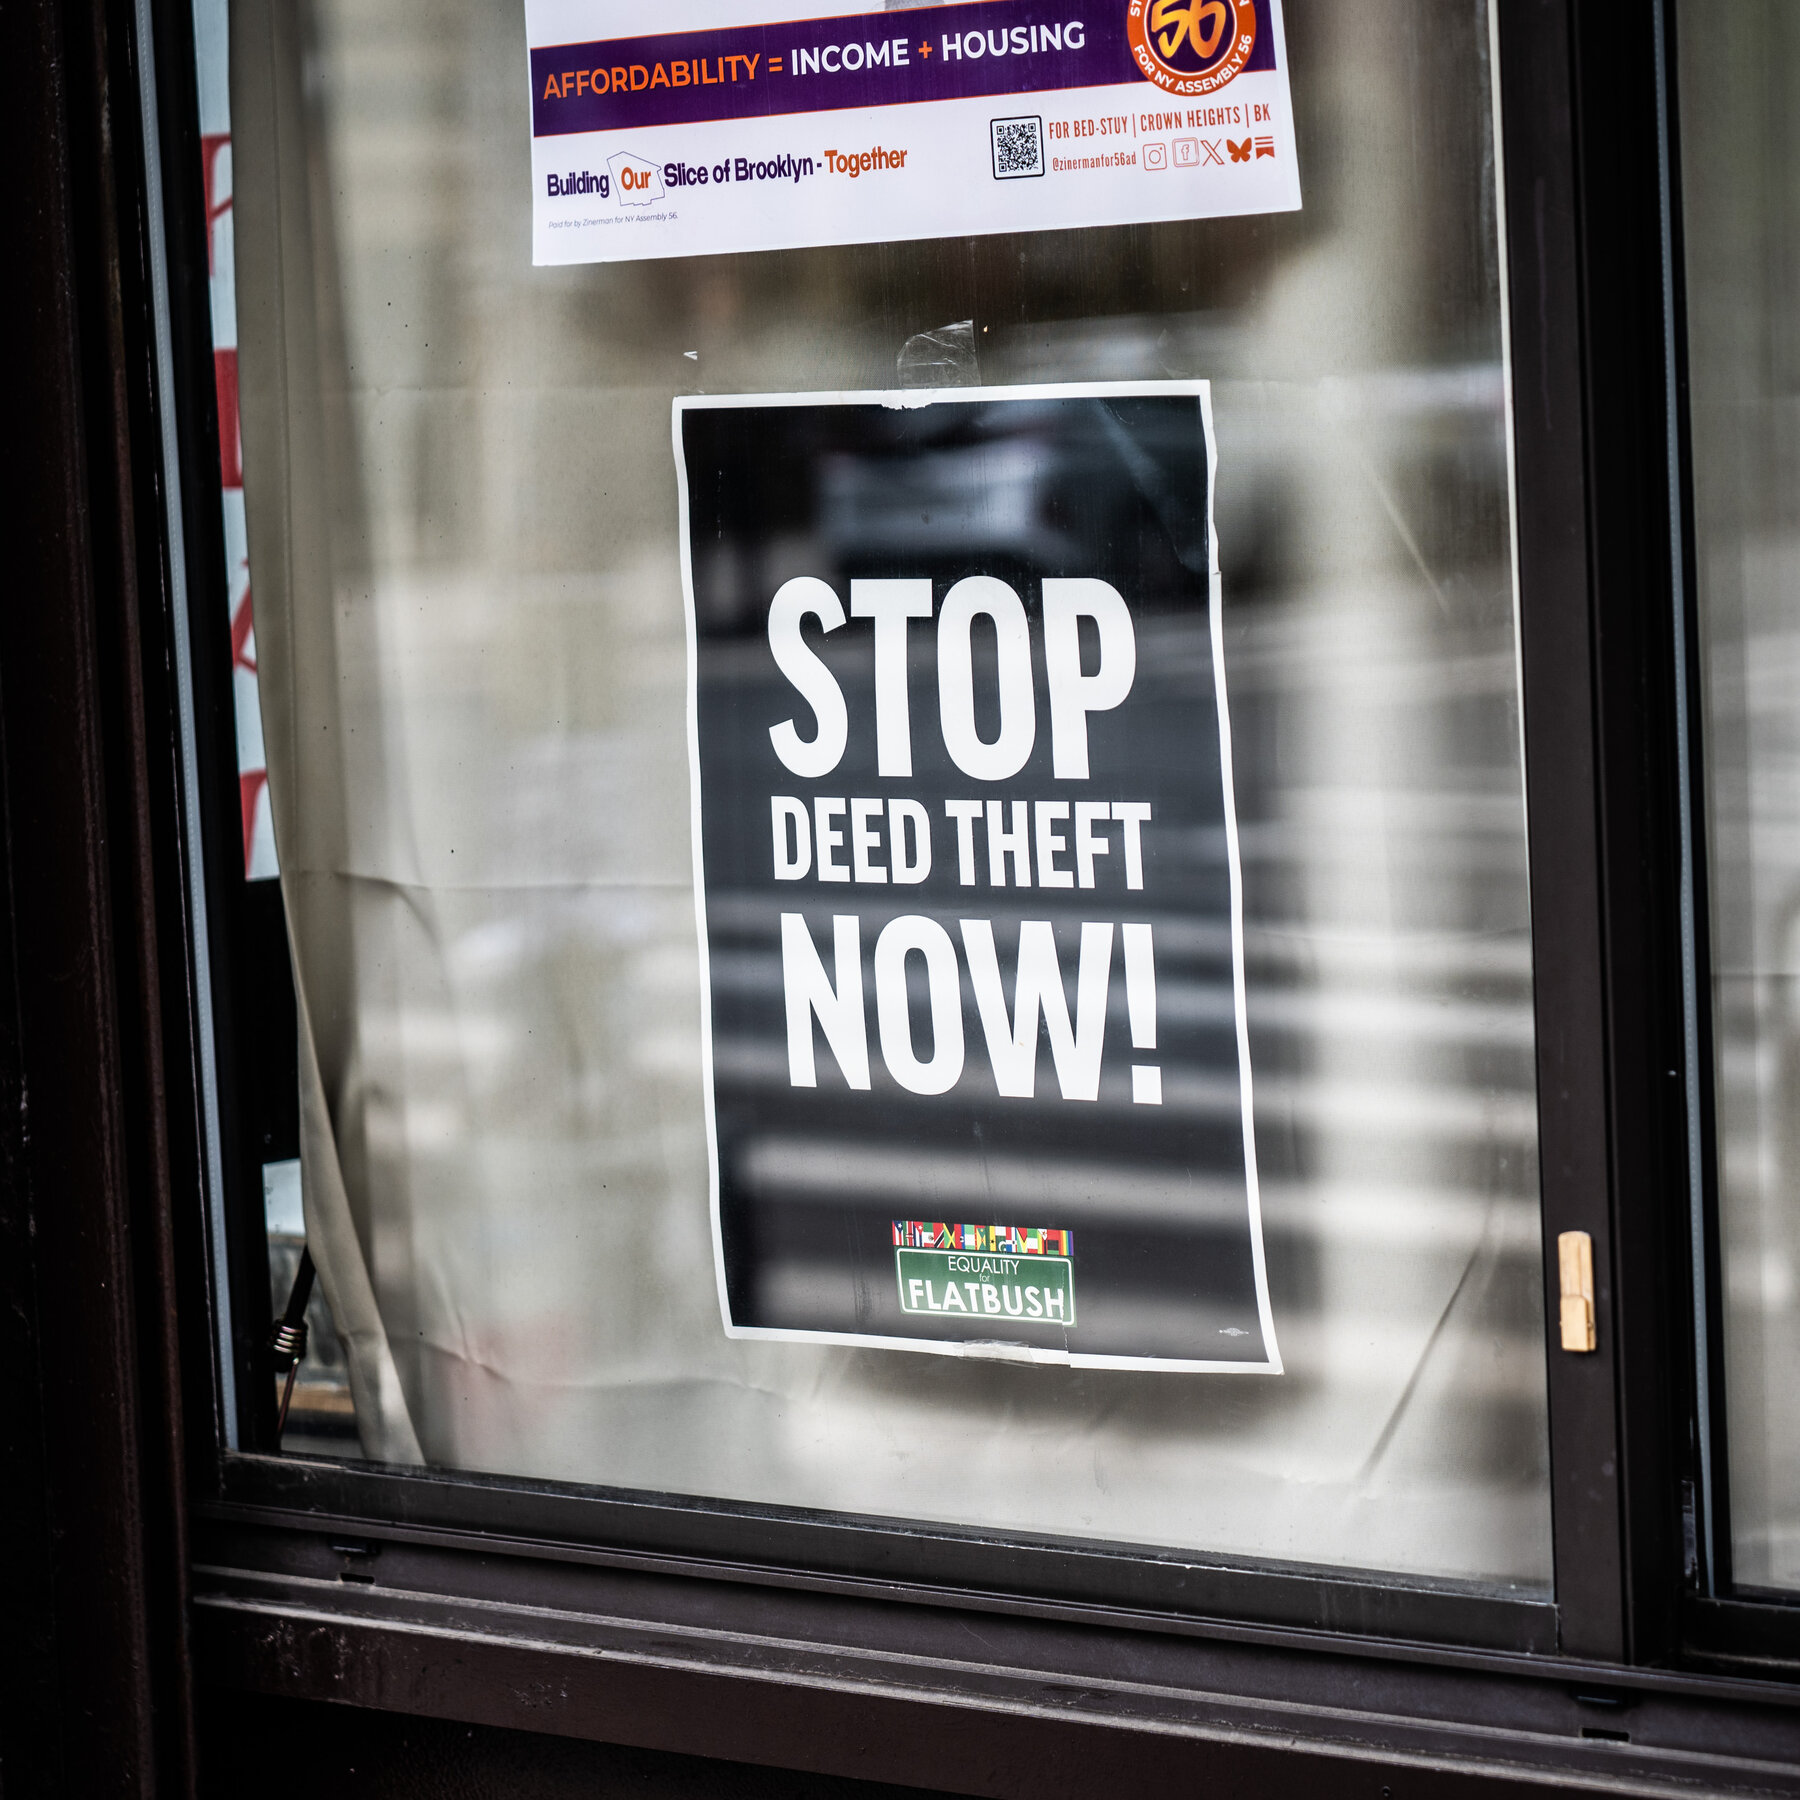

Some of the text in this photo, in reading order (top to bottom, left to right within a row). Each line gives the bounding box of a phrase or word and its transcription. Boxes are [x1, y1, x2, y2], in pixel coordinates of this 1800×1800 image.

[543, 54, 761, 99] AFFORDABILITY
[792, 38, 910, 76] INCOME
[942, 21, 1086, 62] HOUSING
[1134, 34, 1252, 93] FOR NY ASSEMBLY 56
[1049, 122, 1070, 139] FOR
[1074, 116, 1128, 137] BED-STUY
[1140, 111, 1182, 132] CROWN
[1187, 106, 1241, 127] HEIGHTS
[1254, 103, 1271, 122] BK
[547, 171, 610, 198] Building
[621, 166, 651, 191] Our
[664, 162, 709, 187] Slice
[713, 158, 731, 183] of
[735, 153, 814, 183] Brooklyn
[824, 145, 908, 178] Together
[1052, 152, 1137, 172] @zinermanfor56ad
[548, 221, 563, 229] Paid
[564, 219, 573, 228] for
[573, 218, 582, 227] by
[582, 217, 614, 227] Zinerman
[614, 216, 625, 224] for
[635, 212, 668, 222] Assembly
[767, 575, 1137, 781] STOP
[771, 795, 1152, 890] DEED THEFT
[780, 912, 1163, 1105] NOW!
[947, 1255, 1020, 1275] EQUALITY
[979, 1273, 990, 1282] for
[908, 1278, 1065, 1318] FLATBUSH
